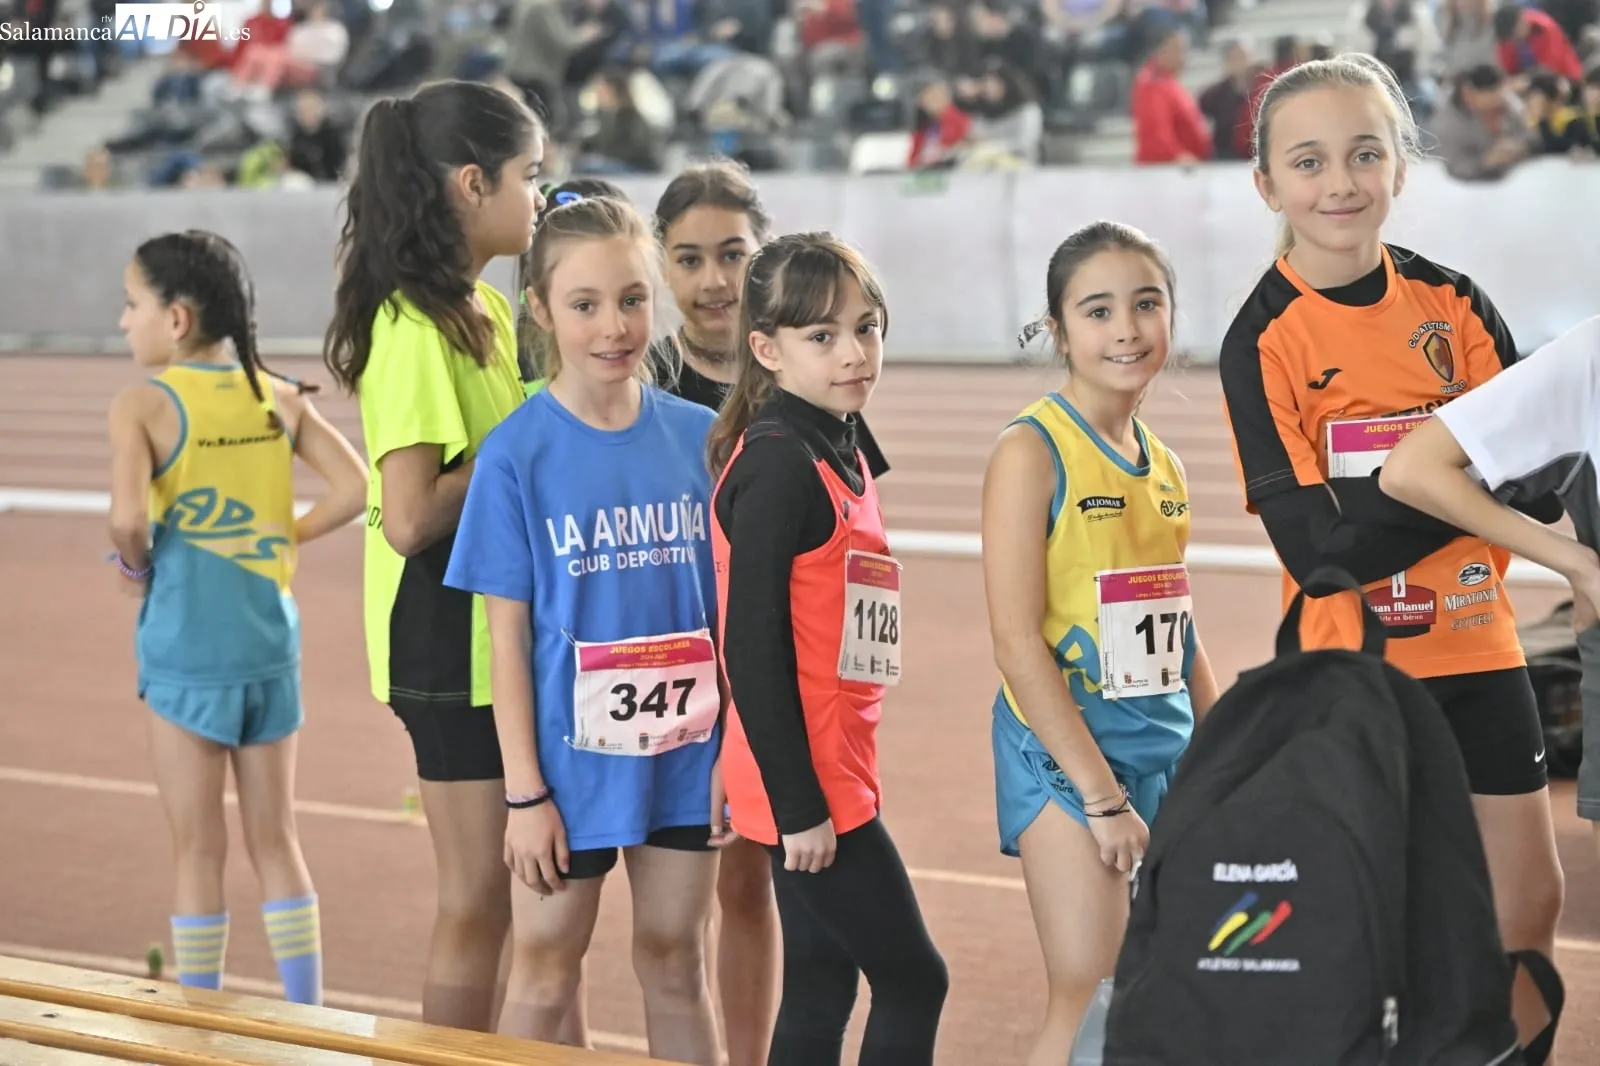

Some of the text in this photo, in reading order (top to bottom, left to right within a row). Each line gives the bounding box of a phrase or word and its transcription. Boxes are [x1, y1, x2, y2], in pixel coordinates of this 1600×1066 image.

[1363, 424, 1403, 434] JUEGOS
[1086, 498, 1121, 508] ALJOMAR
[546, 494, 706, 557] LA ARMUÑA
[568, 554, 610, 577] CLUB
[617, 547, 696, 570] DEPORTIV
[1128, 575, 1156, 584] JUEGOS
[1393, 600, 1434, 613] Manuel
[854, 598, 899, 645] 1128
[1135, 610, 1188, 655] 170
[610, 640, 690, 654] JUEGOS ESCOLARES
[609, 678, 697, 721] 347
[1213, 857, 1299, 882] ELENA GARCÍA
